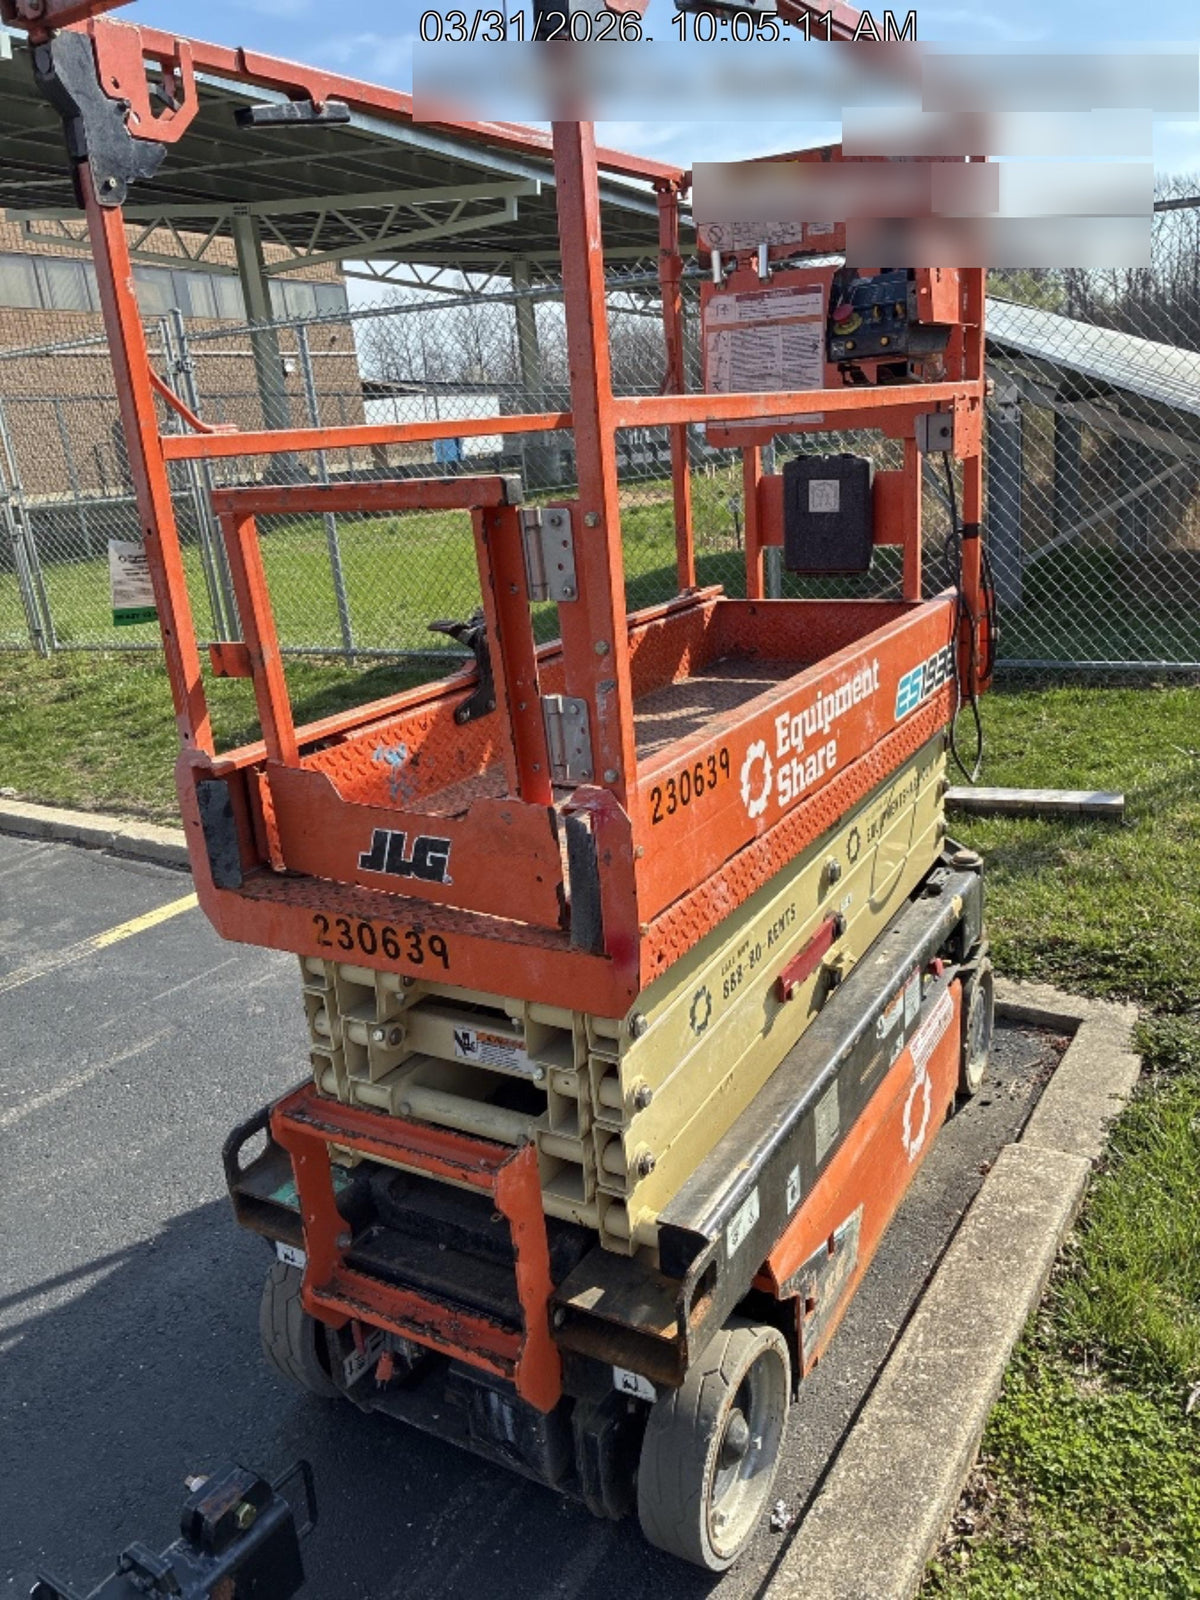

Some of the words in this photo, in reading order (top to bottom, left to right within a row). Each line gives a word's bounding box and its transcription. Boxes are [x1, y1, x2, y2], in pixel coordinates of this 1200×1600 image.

[775, 657, 880, 758] Equipment
[651, 747, 730, 826] 230639
[777, 739, 837, 808] Share
[357, 827, 453, 887] JLG
[312, 913, 450, 970] 230639
